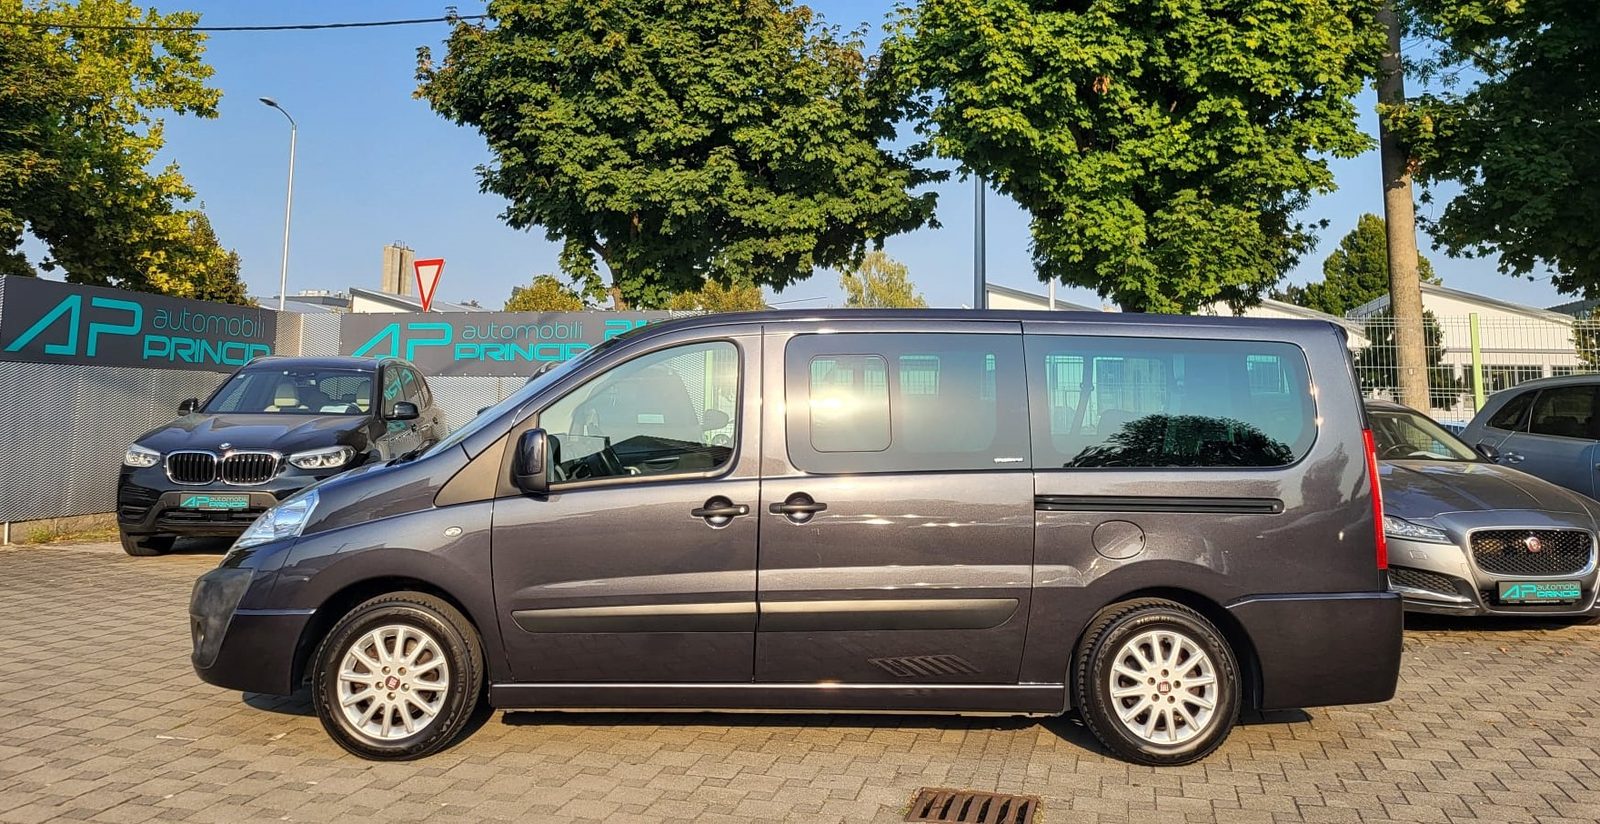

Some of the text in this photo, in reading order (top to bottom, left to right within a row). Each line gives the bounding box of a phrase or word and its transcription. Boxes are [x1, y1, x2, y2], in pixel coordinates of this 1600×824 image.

[4, 294, 143, 357] AP
[153, 307, 265, 338] automobili
[462, 321, 583, 339] automobili
[143, 334, 271, 366] PRINCIP
[352, 322, 453, 361] AP
[455, 343, 591, 361] PRINCIP
[180, 496, 209, 508] AP
[1501, 584, 1537, 598] AP
